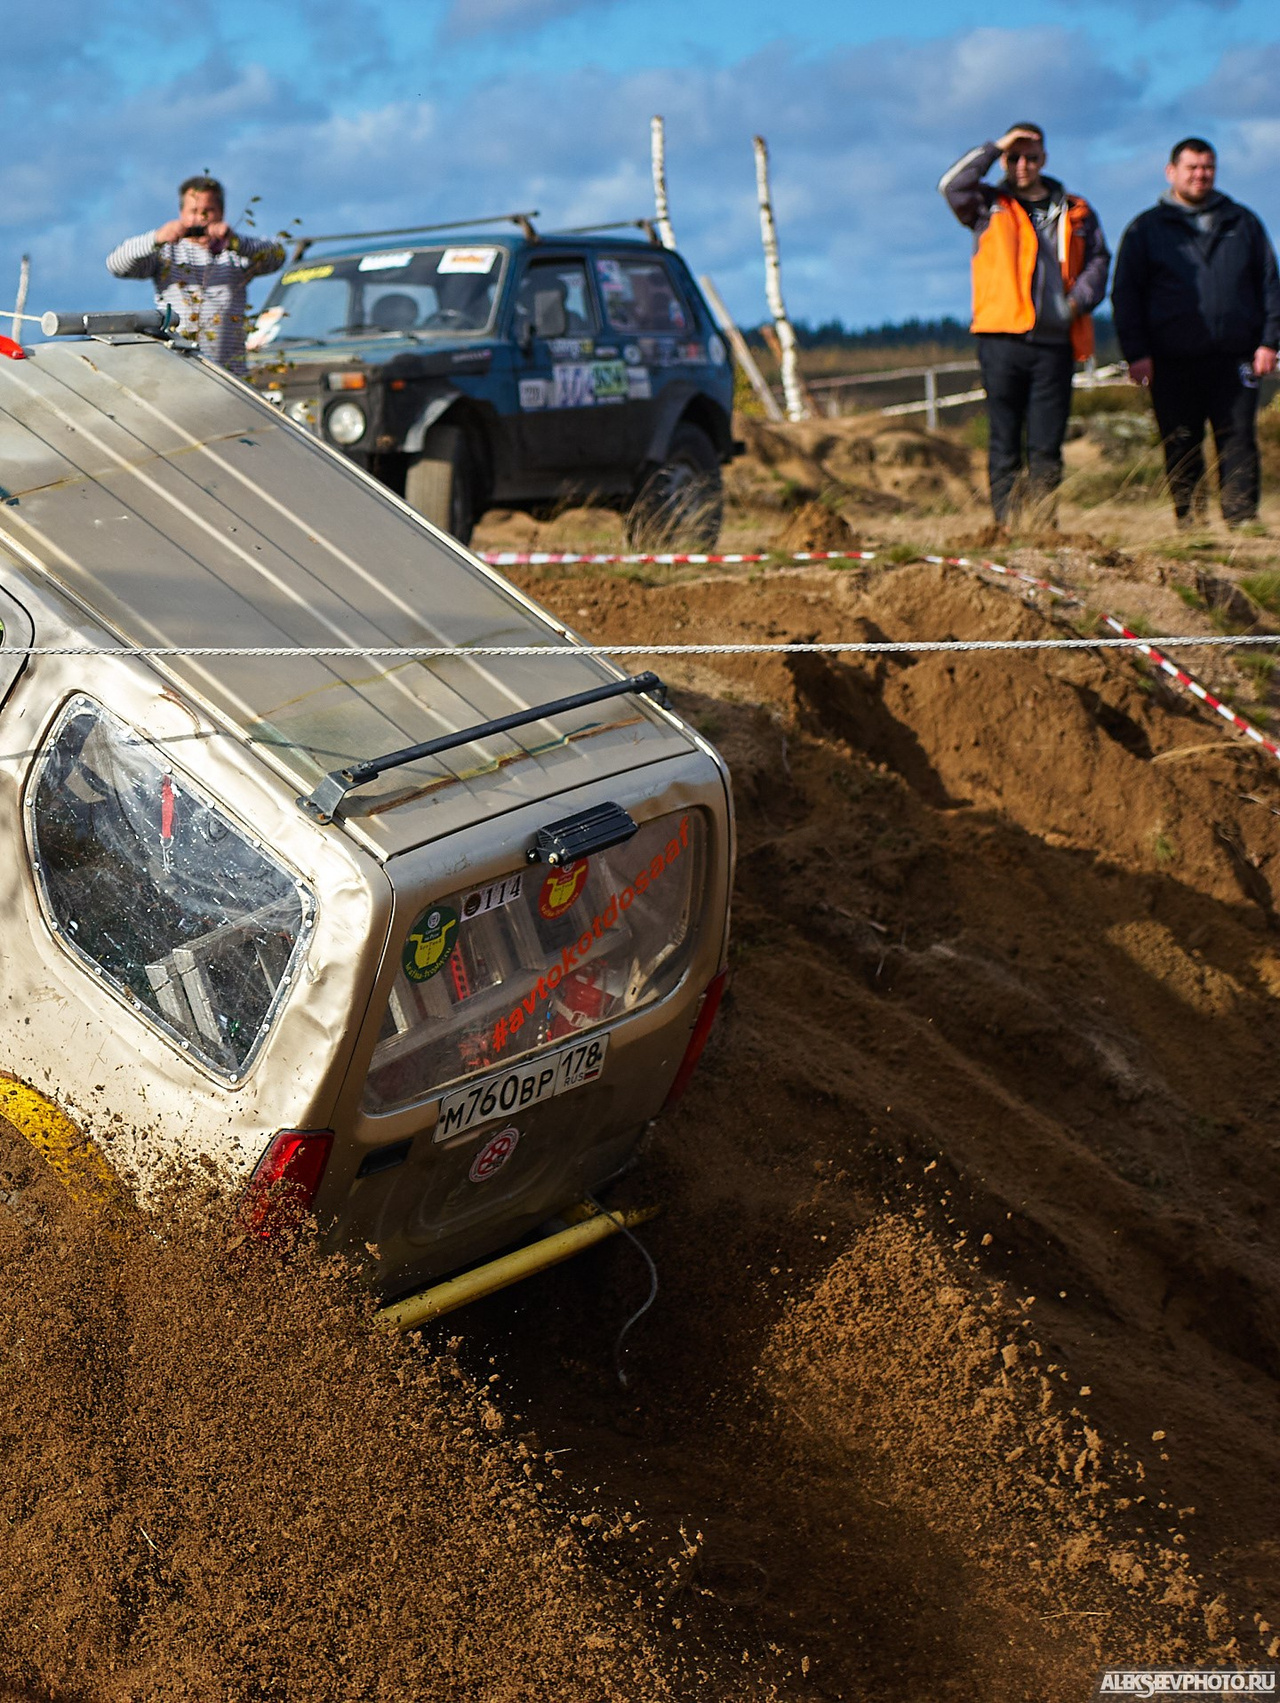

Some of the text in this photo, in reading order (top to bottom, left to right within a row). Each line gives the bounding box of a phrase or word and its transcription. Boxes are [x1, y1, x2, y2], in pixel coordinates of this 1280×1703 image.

[484, 875, 521, 910] 114
[492, 815, 689, 1053] #avtokotdosaaf
[562, 1041, 600, 1078] 178
[563, 1071, 584, 1087] RUS
